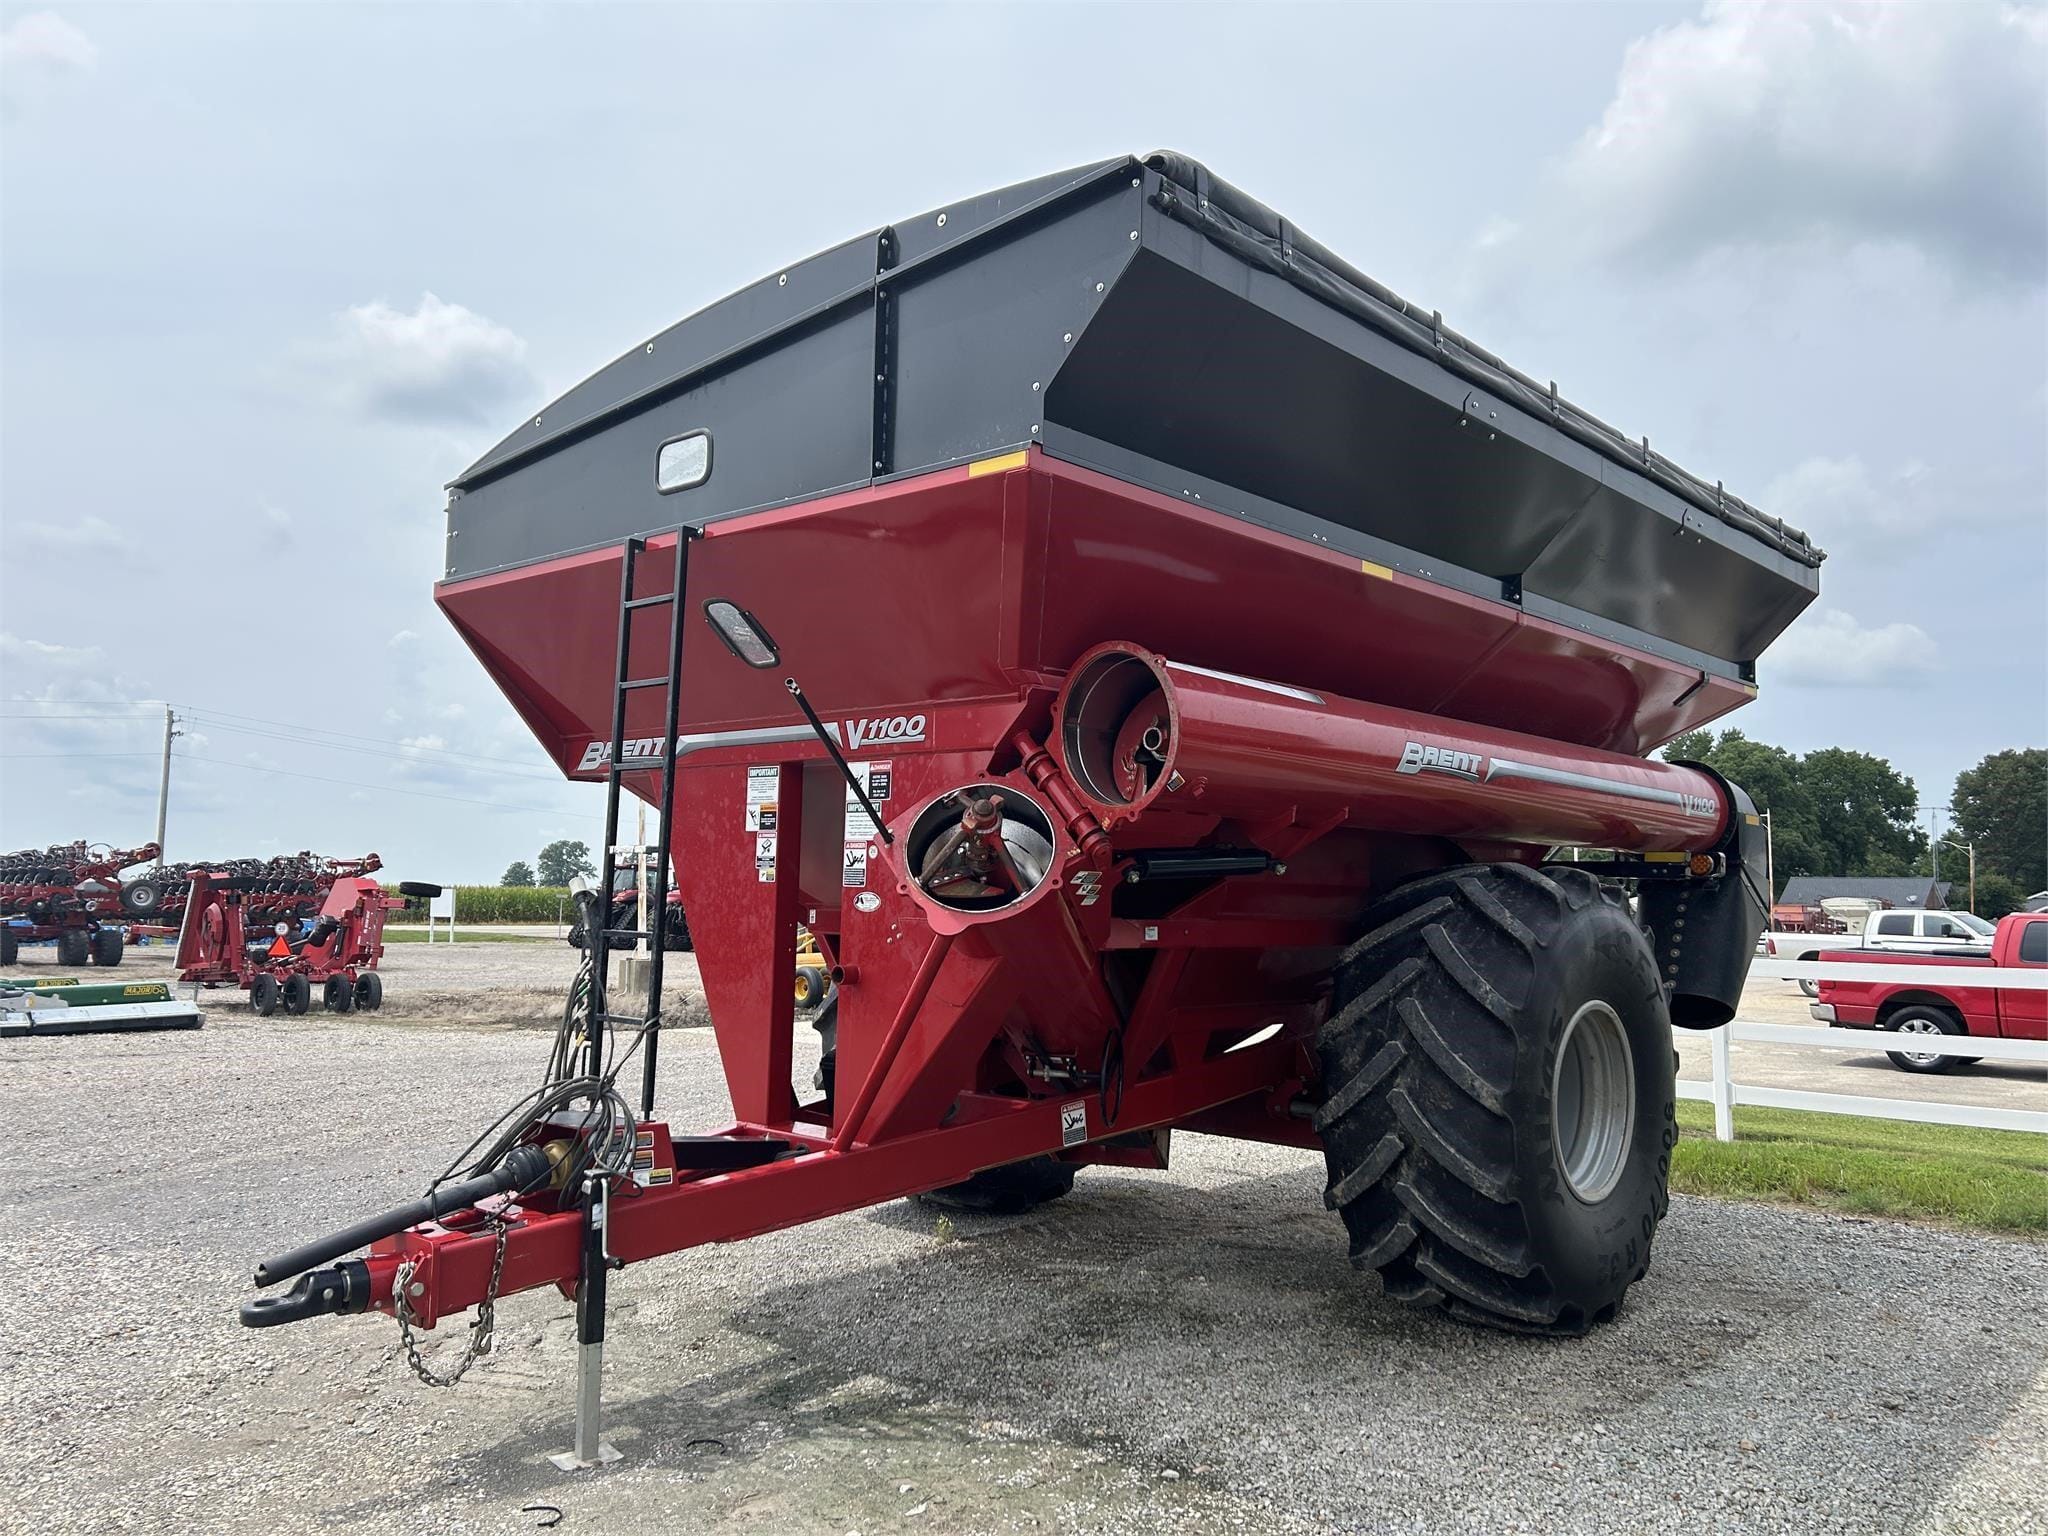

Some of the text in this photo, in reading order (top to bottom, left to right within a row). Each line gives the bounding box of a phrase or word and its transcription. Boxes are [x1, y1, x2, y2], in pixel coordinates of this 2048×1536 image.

[845, 714, 926, 750] V1100
[1394, 741, 1483, 774] BRENT
[749, 767, 778, 777] IMPORTANT
[847, 802, 880, 812] IMPONT
[1683, 793, 1715, 816] V1100
